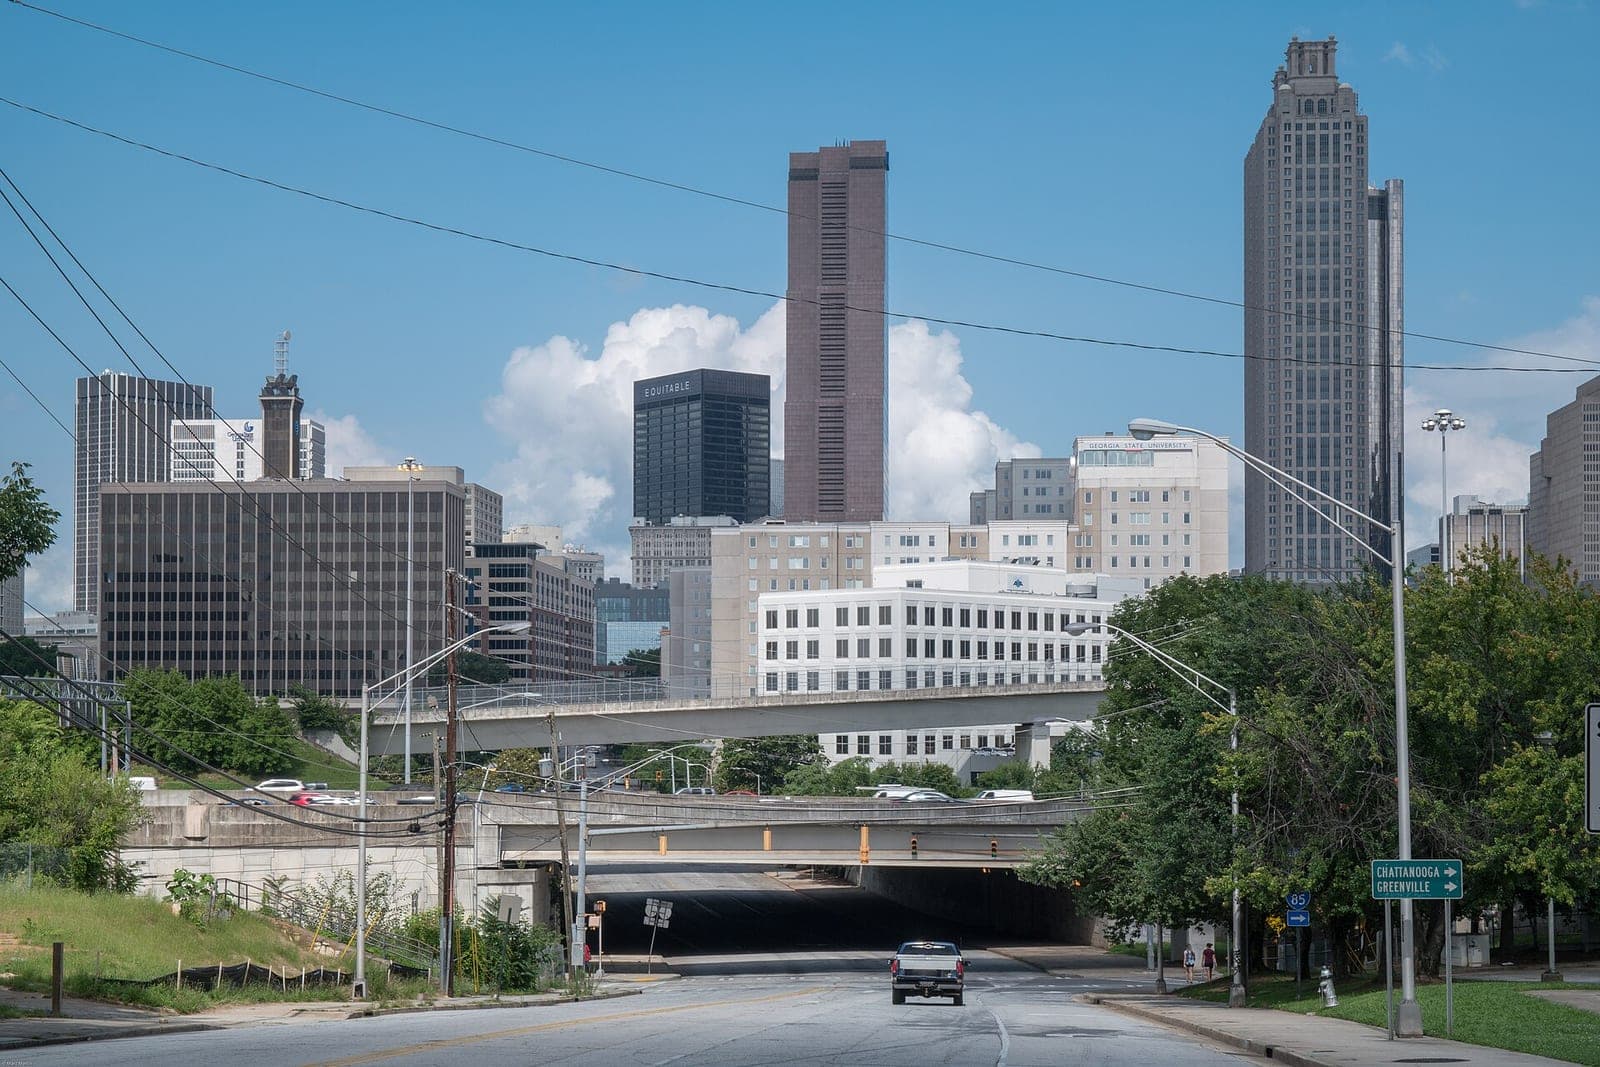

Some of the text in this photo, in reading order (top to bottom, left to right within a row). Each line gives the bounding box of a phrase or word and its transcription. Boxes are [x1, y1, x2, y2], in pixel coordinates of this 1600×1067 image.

[645, 381, 690, 397] EQUITABLE
[1377, 866, 1440, 878] CHATTANOOGA
[1377, 881, 1430, 893] GREENVILLE
[1291, 894, 1306, 906] 85
